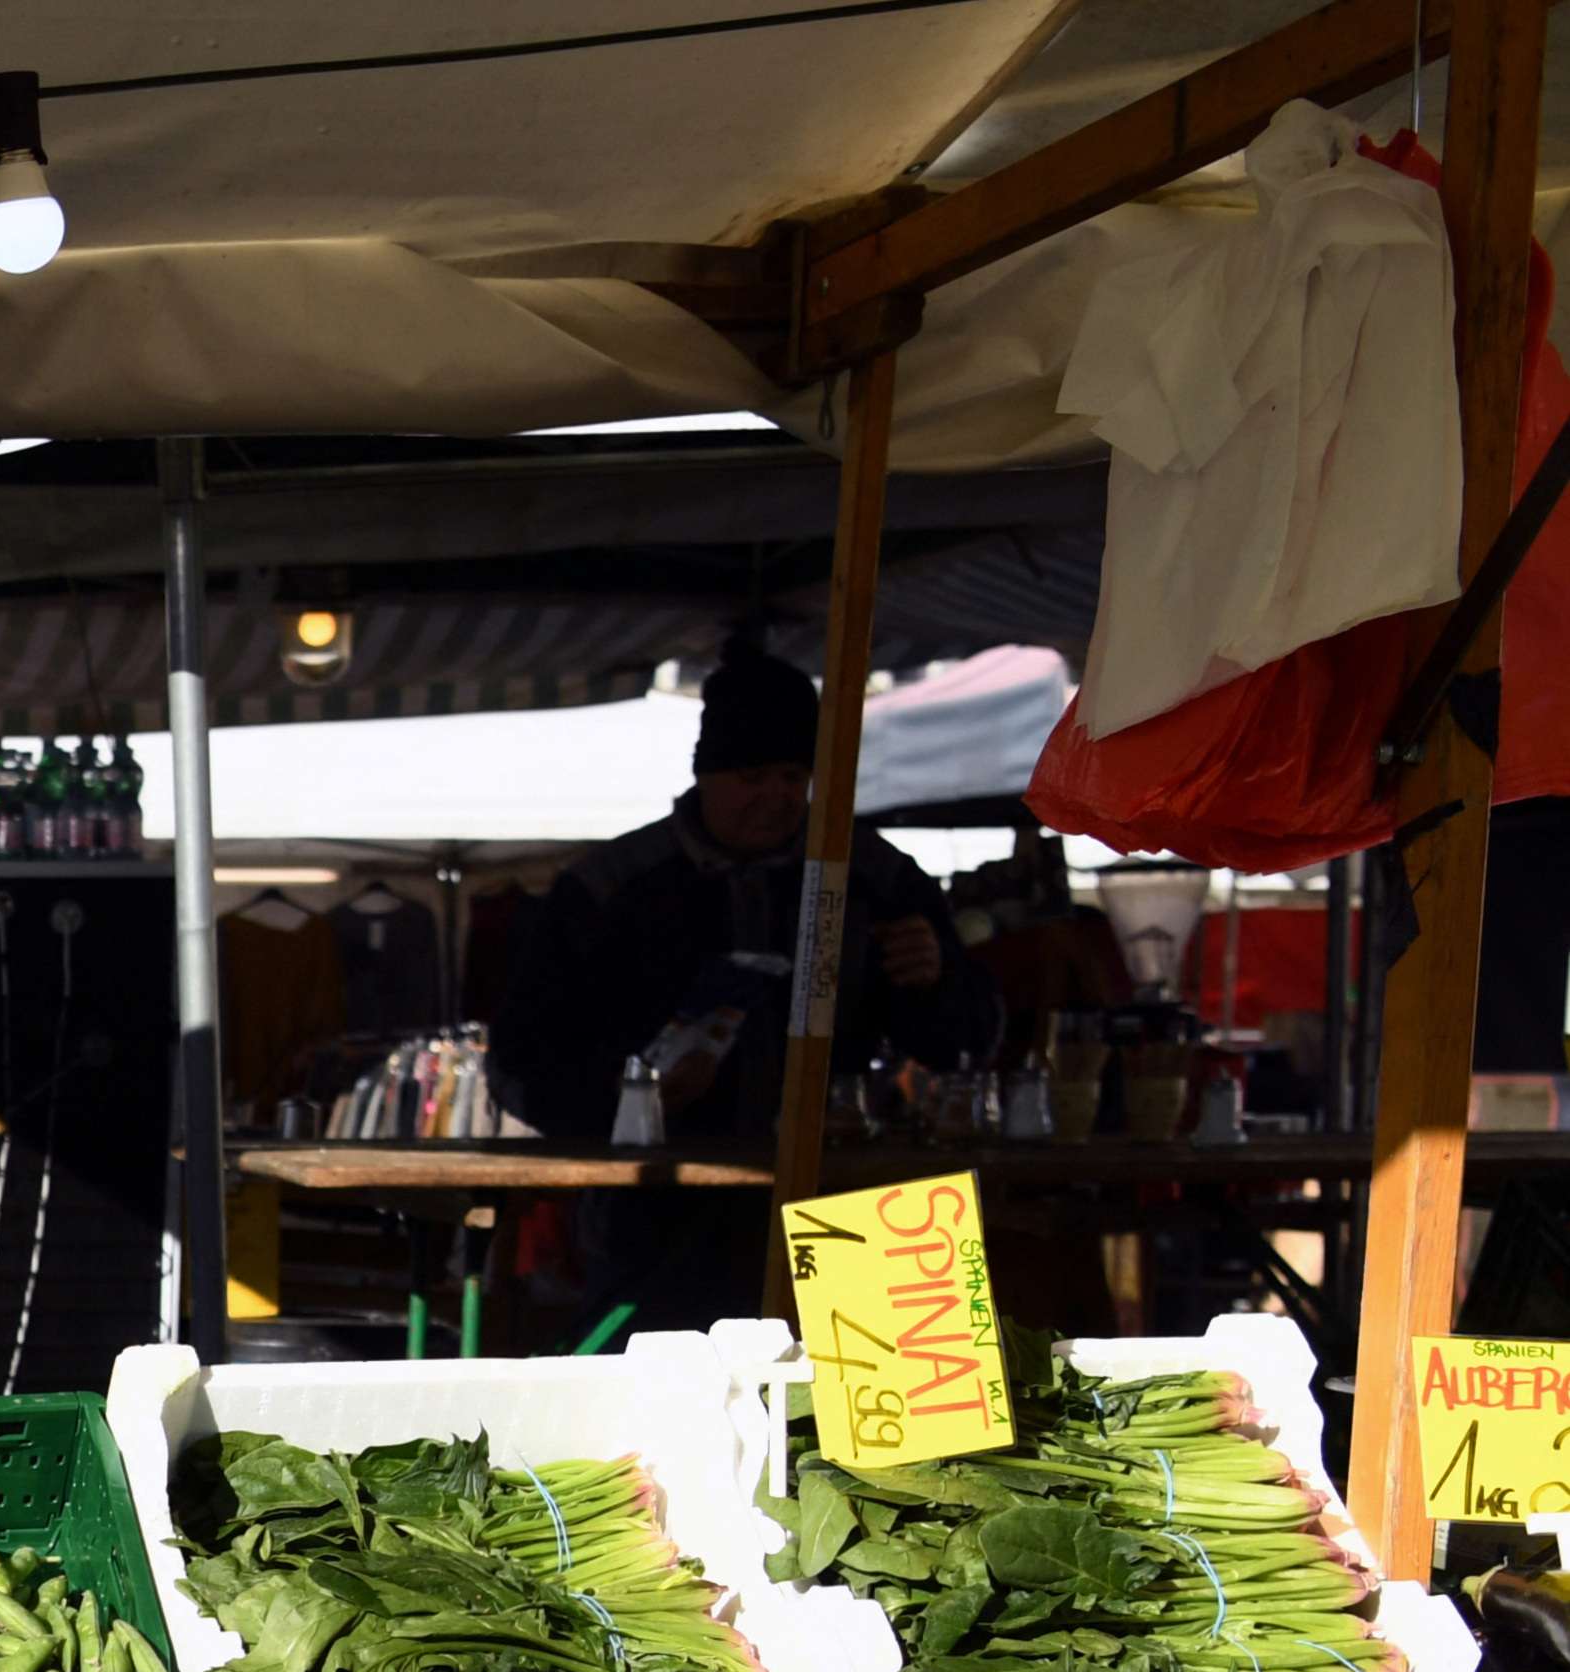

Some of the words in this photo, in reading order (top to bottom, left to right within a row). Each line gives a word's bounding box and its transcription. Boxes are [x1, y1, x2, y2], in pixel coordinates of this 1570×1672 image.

[877, 1185, 989, 1431] SPINAT
[960, 1239, 1001, 1347] SPANIEN
[1473, 1341, 1554, 1360] SPANIEN
